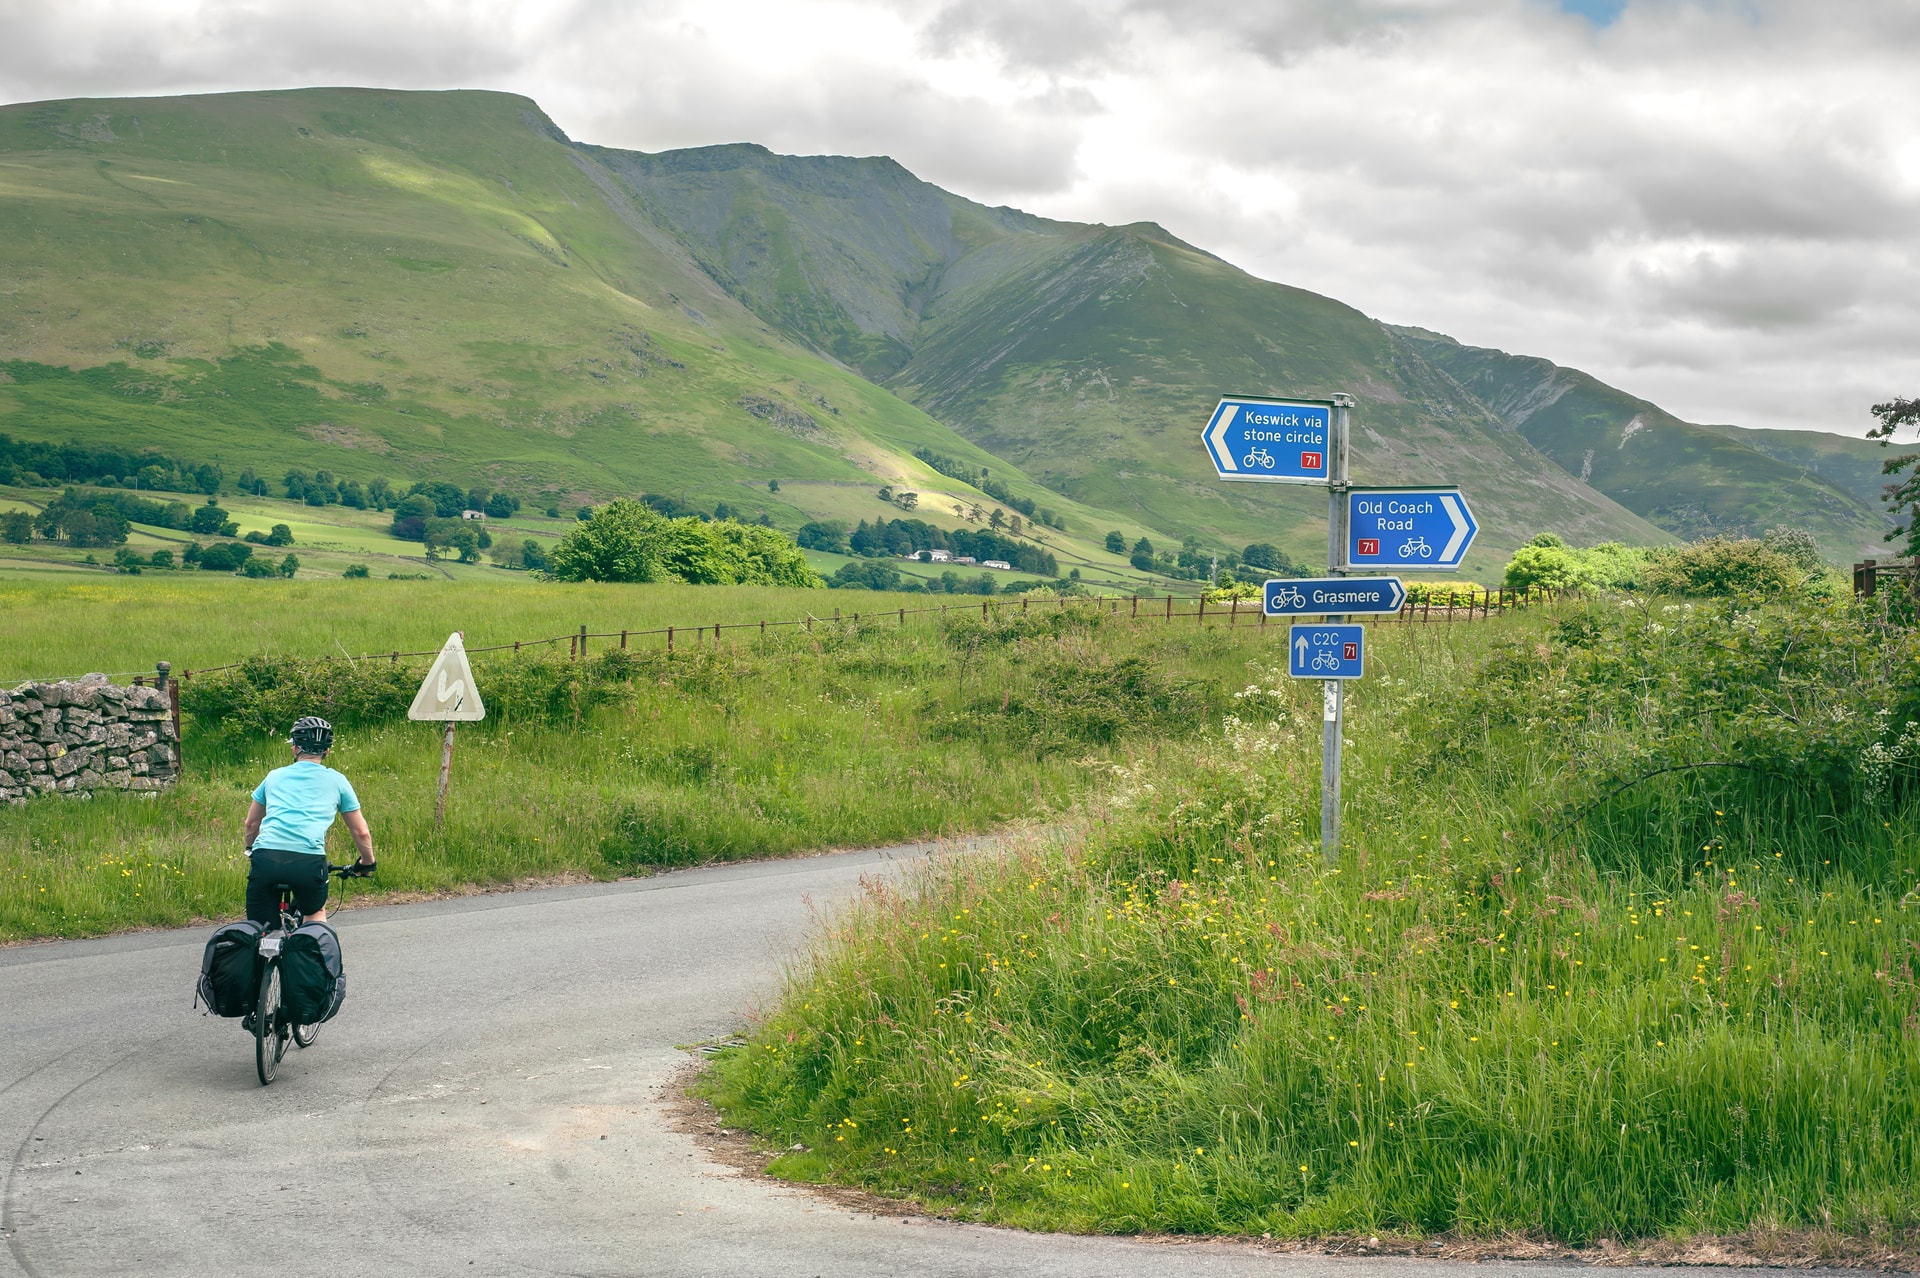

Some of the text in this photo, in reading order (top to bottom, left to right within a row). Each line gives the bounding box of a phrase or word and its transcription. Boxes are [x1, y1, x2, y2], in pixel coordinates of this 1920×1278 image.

[1245, 411, 1322, 428] Keswick via
[1244, 430, 1323, 444] stone circle
[1306, 455, 1317, 467] 71
[1358, 501, 1433, 514] Old Coach
[1377, 518, 1413, 530] Road
[1362, 542, 1374, 553] 71
[1313, 590, 1380, 604] Grasmere
[1312, 632, 1339, 646] C2C
[1345, 646, 1355, 657] 71
